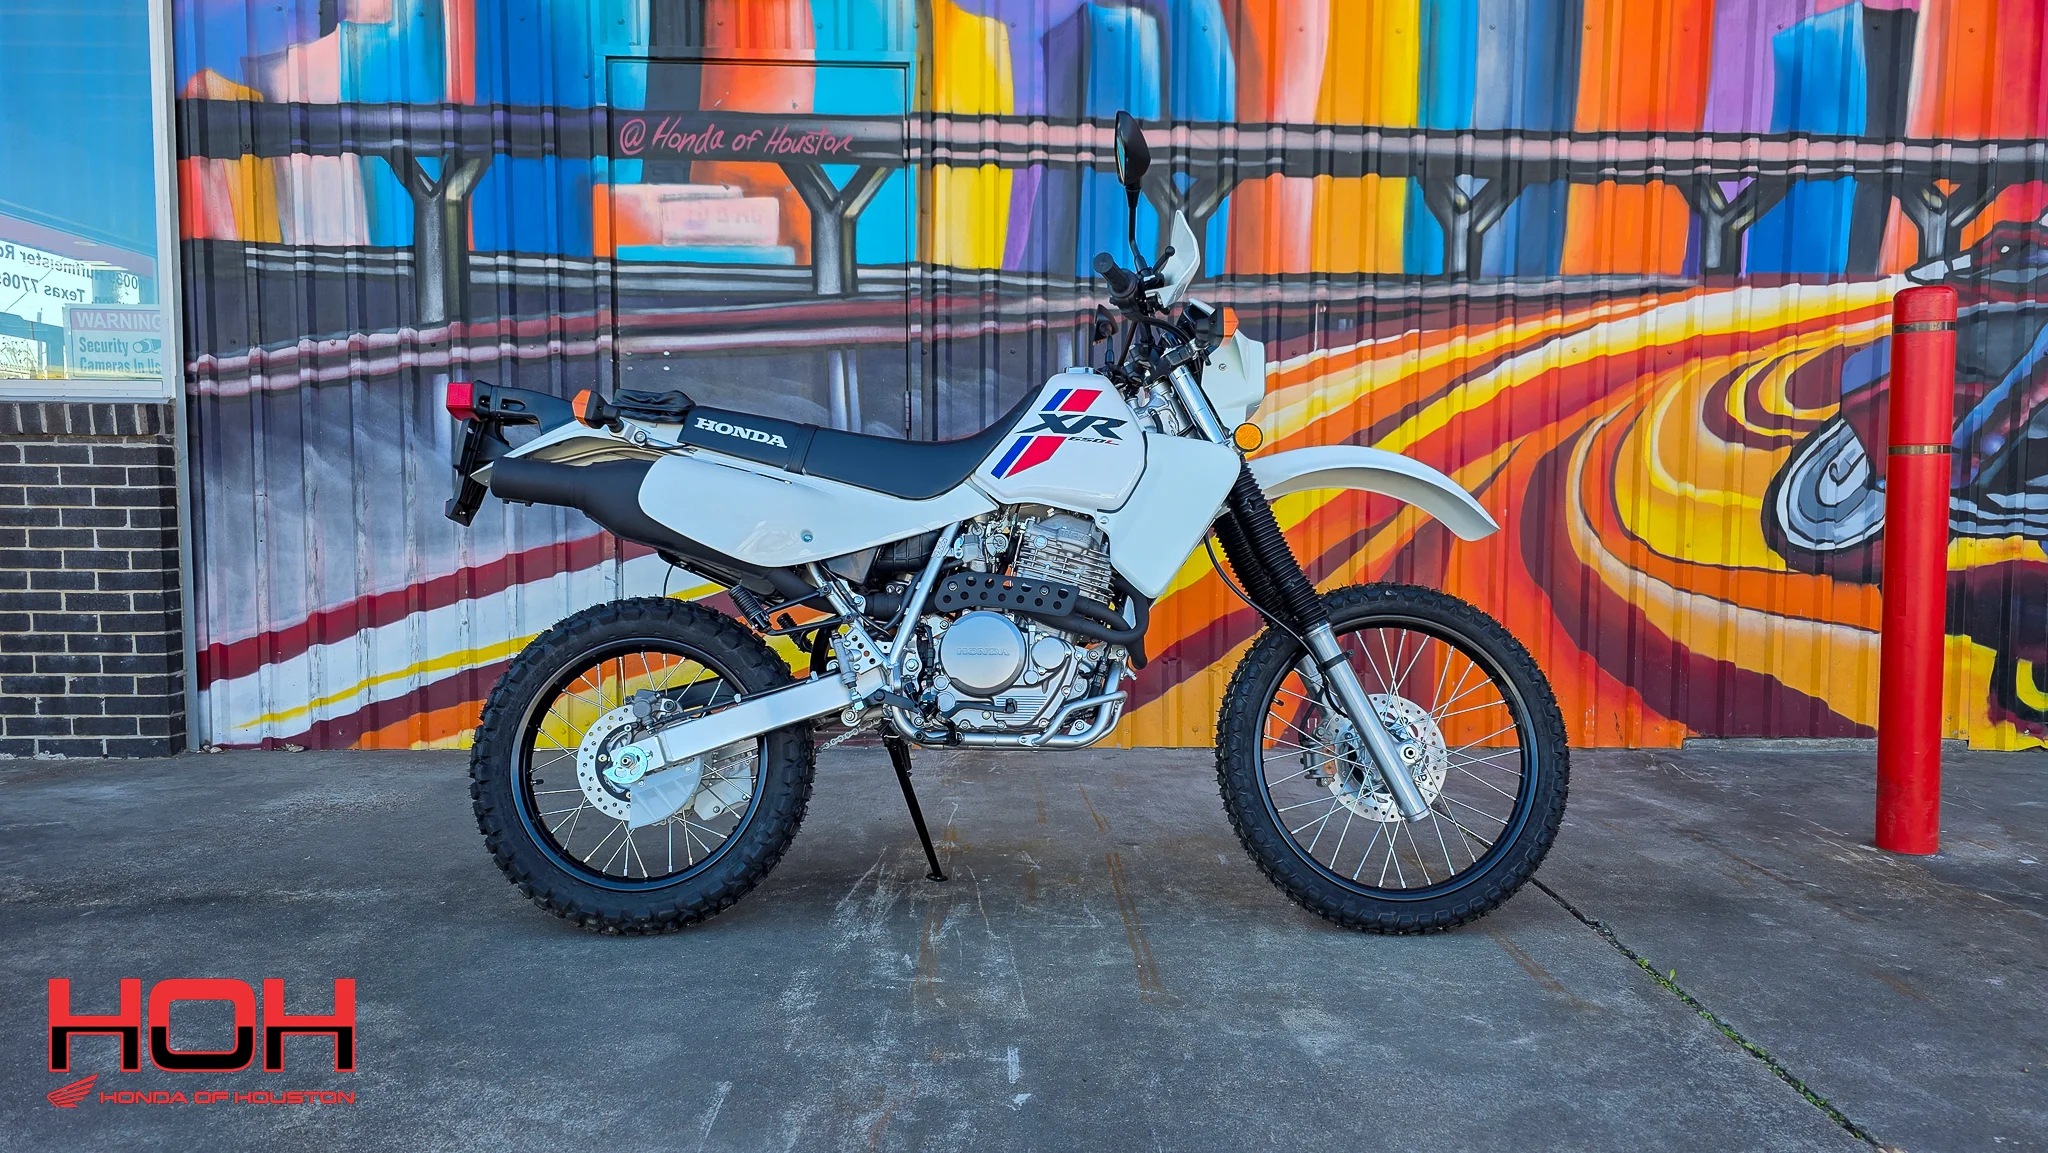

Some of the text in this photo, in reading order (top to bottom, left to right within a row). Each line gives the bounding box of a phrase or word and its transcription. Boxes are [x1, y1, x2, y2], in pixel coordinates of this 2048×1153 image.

[620, 115, 853, 155] @ Honda of Houston
[79, 336, 128, 357] Security
[80, 357, 161, 374] Cameras In Us
[694, 417, 788, 449] HONDA
[1014, 413, 1128, 441] XR
[1067, 436, 1120, 446] 650L
[956, 647, 1010, 656] HONDA
